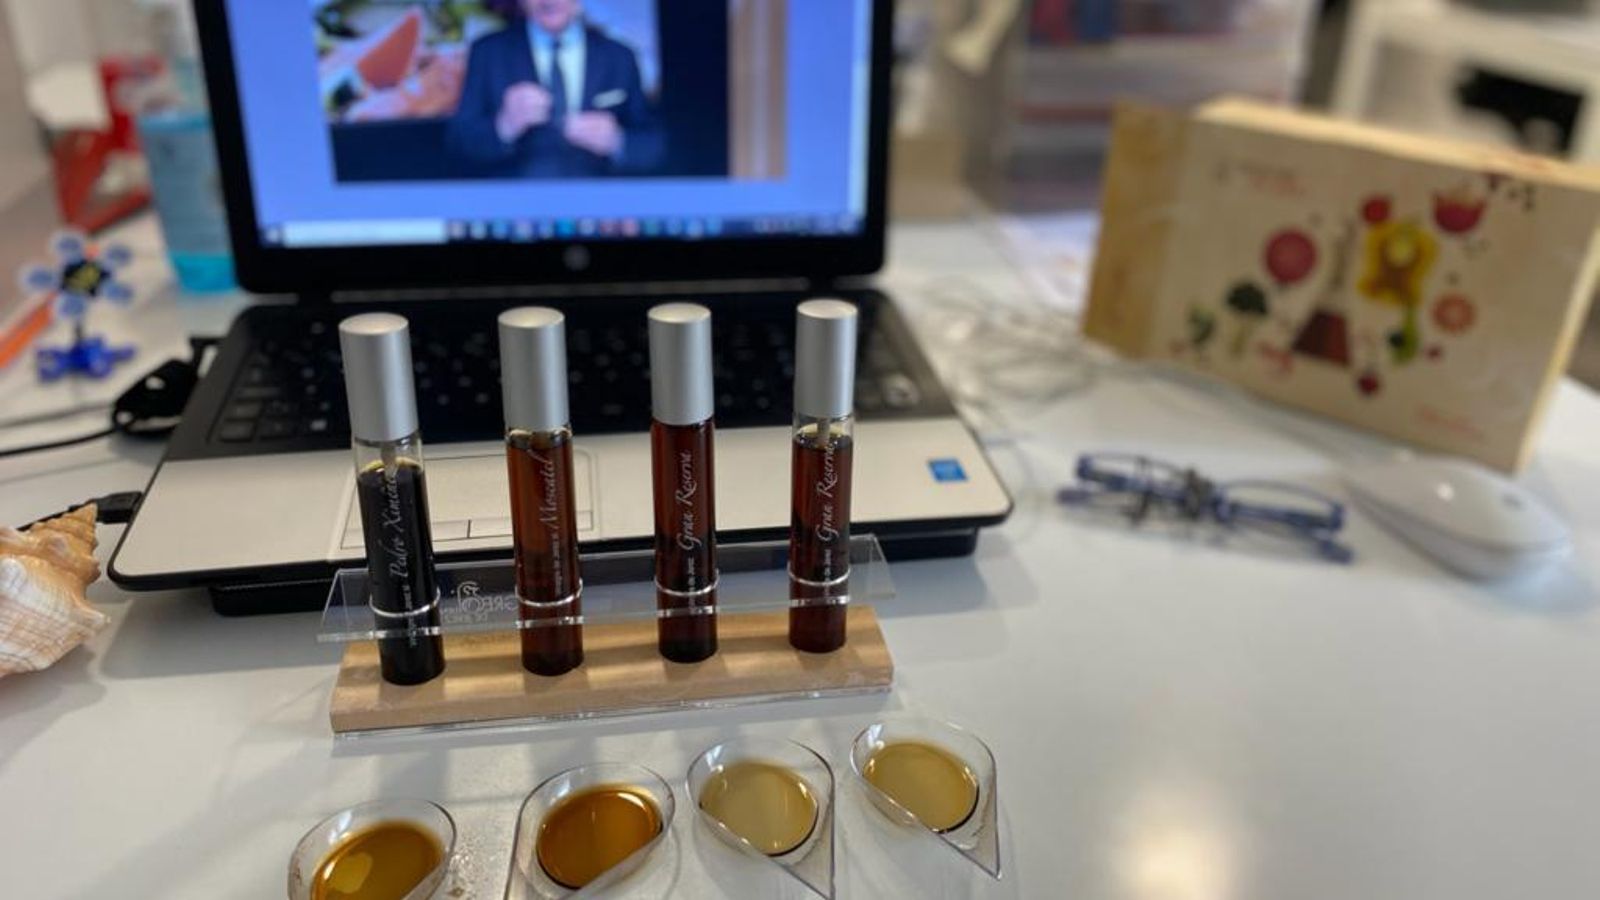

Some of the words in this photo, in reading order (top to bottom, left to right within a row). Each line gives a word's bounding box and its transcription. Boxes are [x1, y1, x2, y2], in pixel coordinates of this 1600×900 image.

[527, 448, 558, 529] Moscatel
[675, 450, 698, 506] Reserva
[677, 512, 702, 550] Gran
[815, 504, 839, 541] Gran
[377, 538, 408, 577] Pedro
